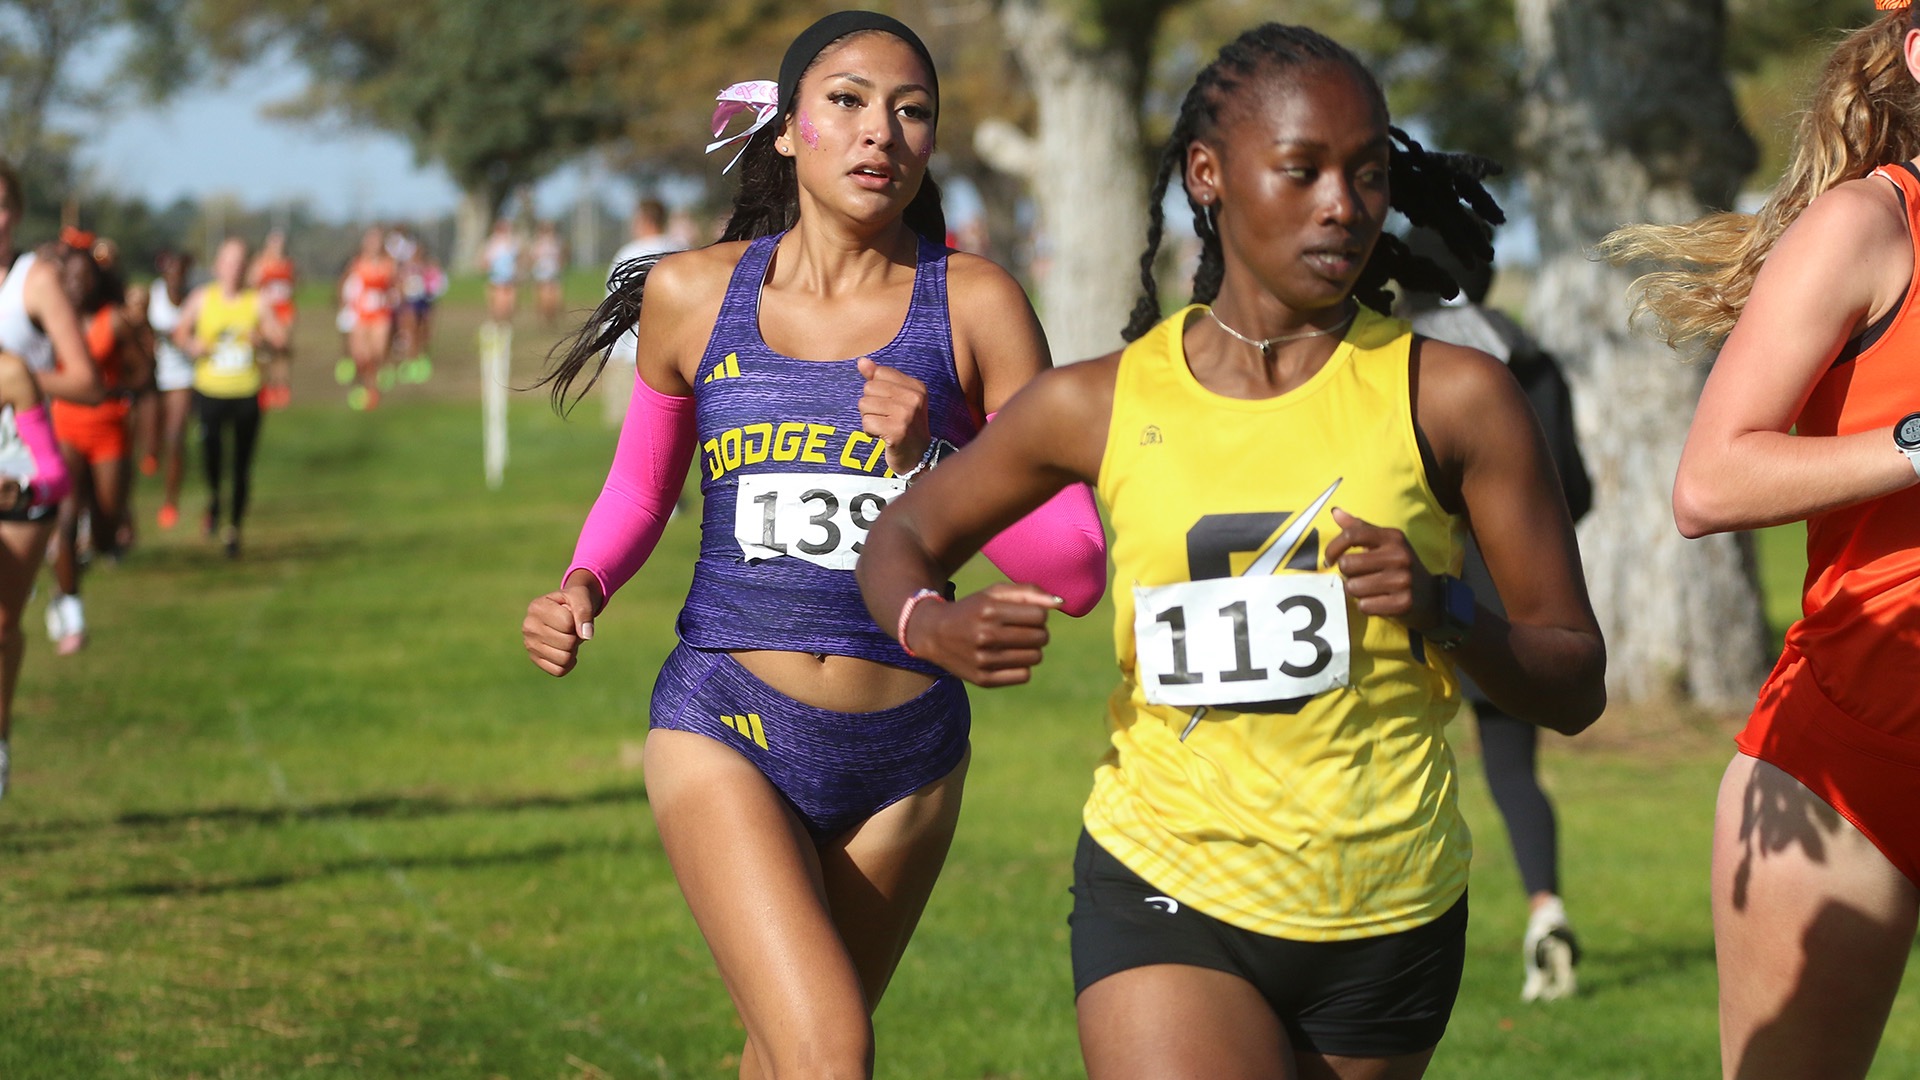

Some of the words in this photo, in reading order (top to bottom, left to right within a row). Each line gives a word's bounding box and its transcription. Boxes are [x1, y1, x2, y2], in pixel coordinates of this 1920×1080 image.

[704, 422, 836, 481] DODGE
[839, 431, 894, 478] CI
[753, 488, 887, 555] 139
[1155, 594, 1333, 685] 113
